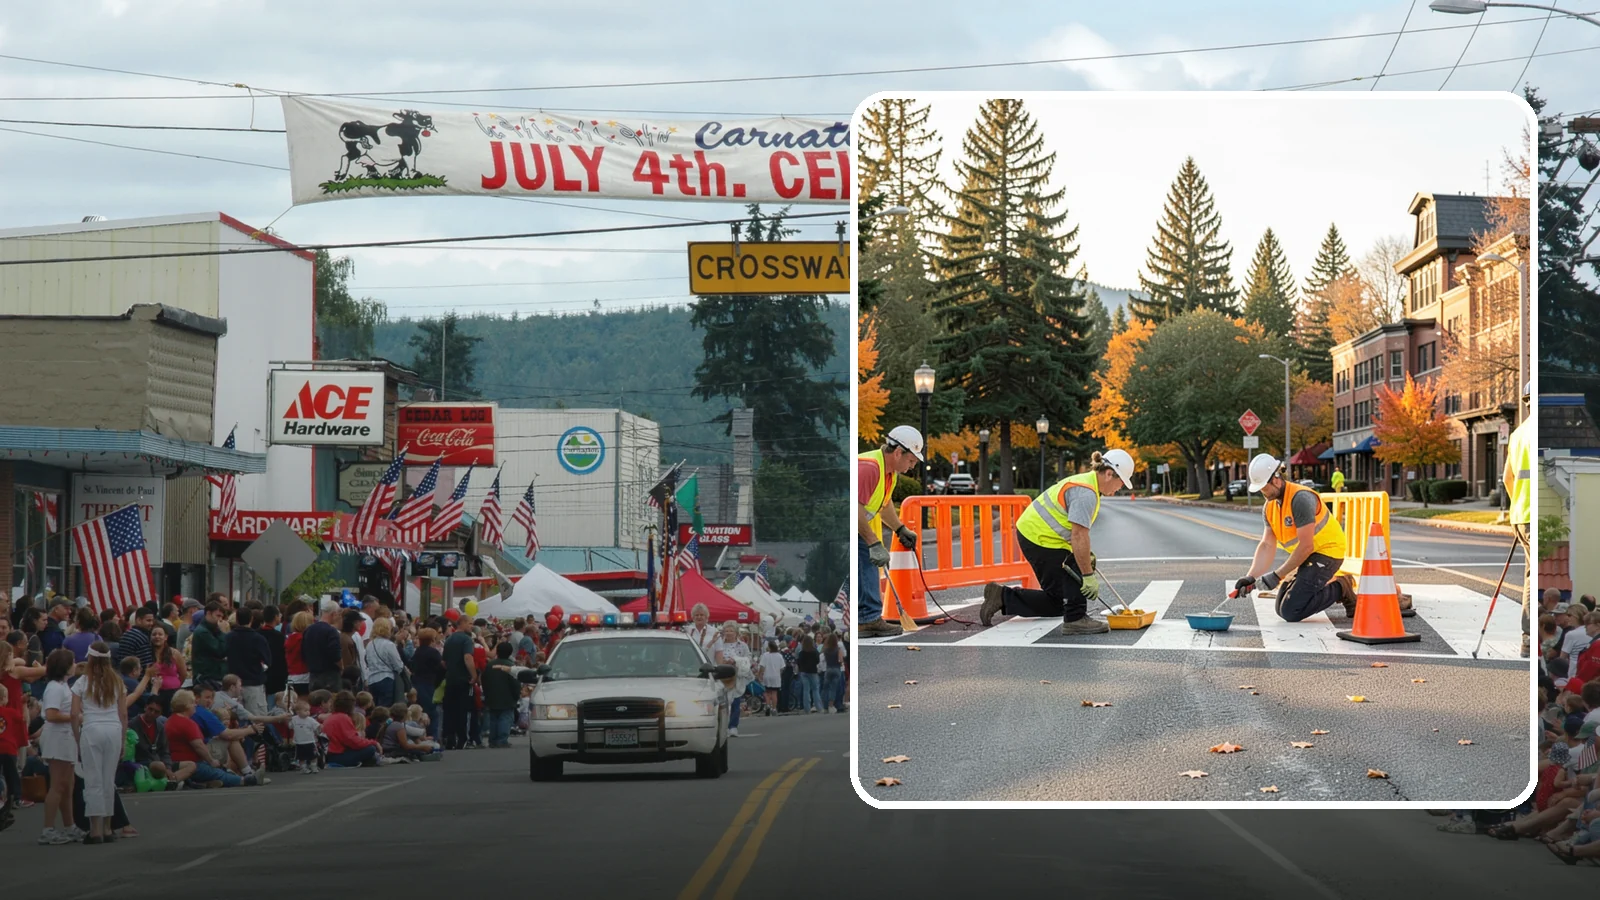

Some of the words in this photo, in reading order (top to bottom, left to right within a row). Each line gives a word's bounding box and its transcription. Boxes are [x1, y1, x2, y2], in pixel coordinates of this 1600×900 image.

[481, 141, 605, 192] JULY
[632, 150, 746, 198] 4th.
[697, 254, 850, 280] CROSSWA
[282, 380, 373, 420] ACE
[406, 409, 452, 421] CEDAR
[461, 409, 485, 421] LOG
[283, 421, 371, 436] Hardware
[416, 428, 477, 446] Coca-Cola
[95, 485, 124, 494] Vincent
[126, 485, 135, 494] de
[138, 486, 155, 495] Paul
[688, 526, 742, 535] CRNATION
[699, 535, 730, 543] GLASS
